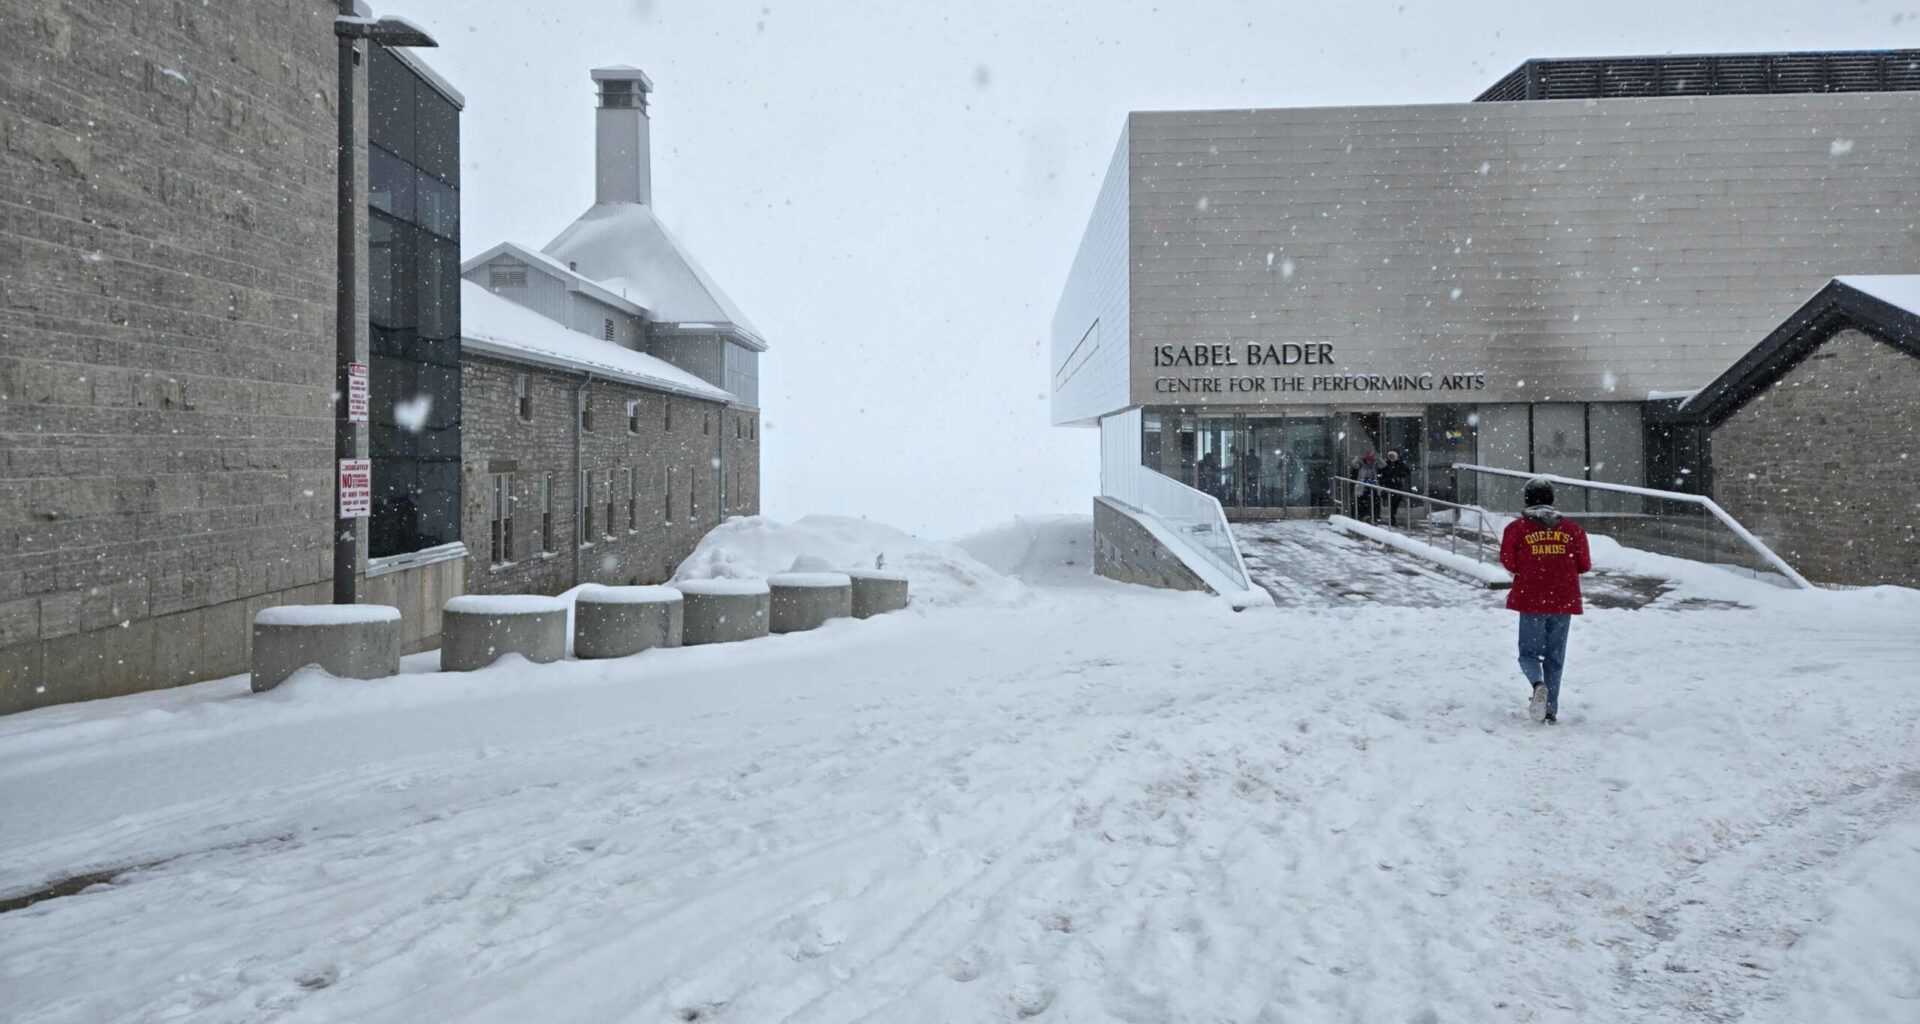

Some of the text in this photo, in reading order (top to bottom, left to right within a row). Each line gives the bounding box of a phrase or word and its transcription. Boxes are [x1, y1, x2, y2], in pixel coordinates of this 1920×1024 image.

[1154, 343, 1335, 366] ISABEL BADER
[1155, 374, 1485, 393] CENTRE FOR THE PERFORMING ARTS
[342, 473, 352, 488] NO
[1525, 530, 1571, 544] QUEEN'S
[1532, 544, 1566, 555] BANDS
